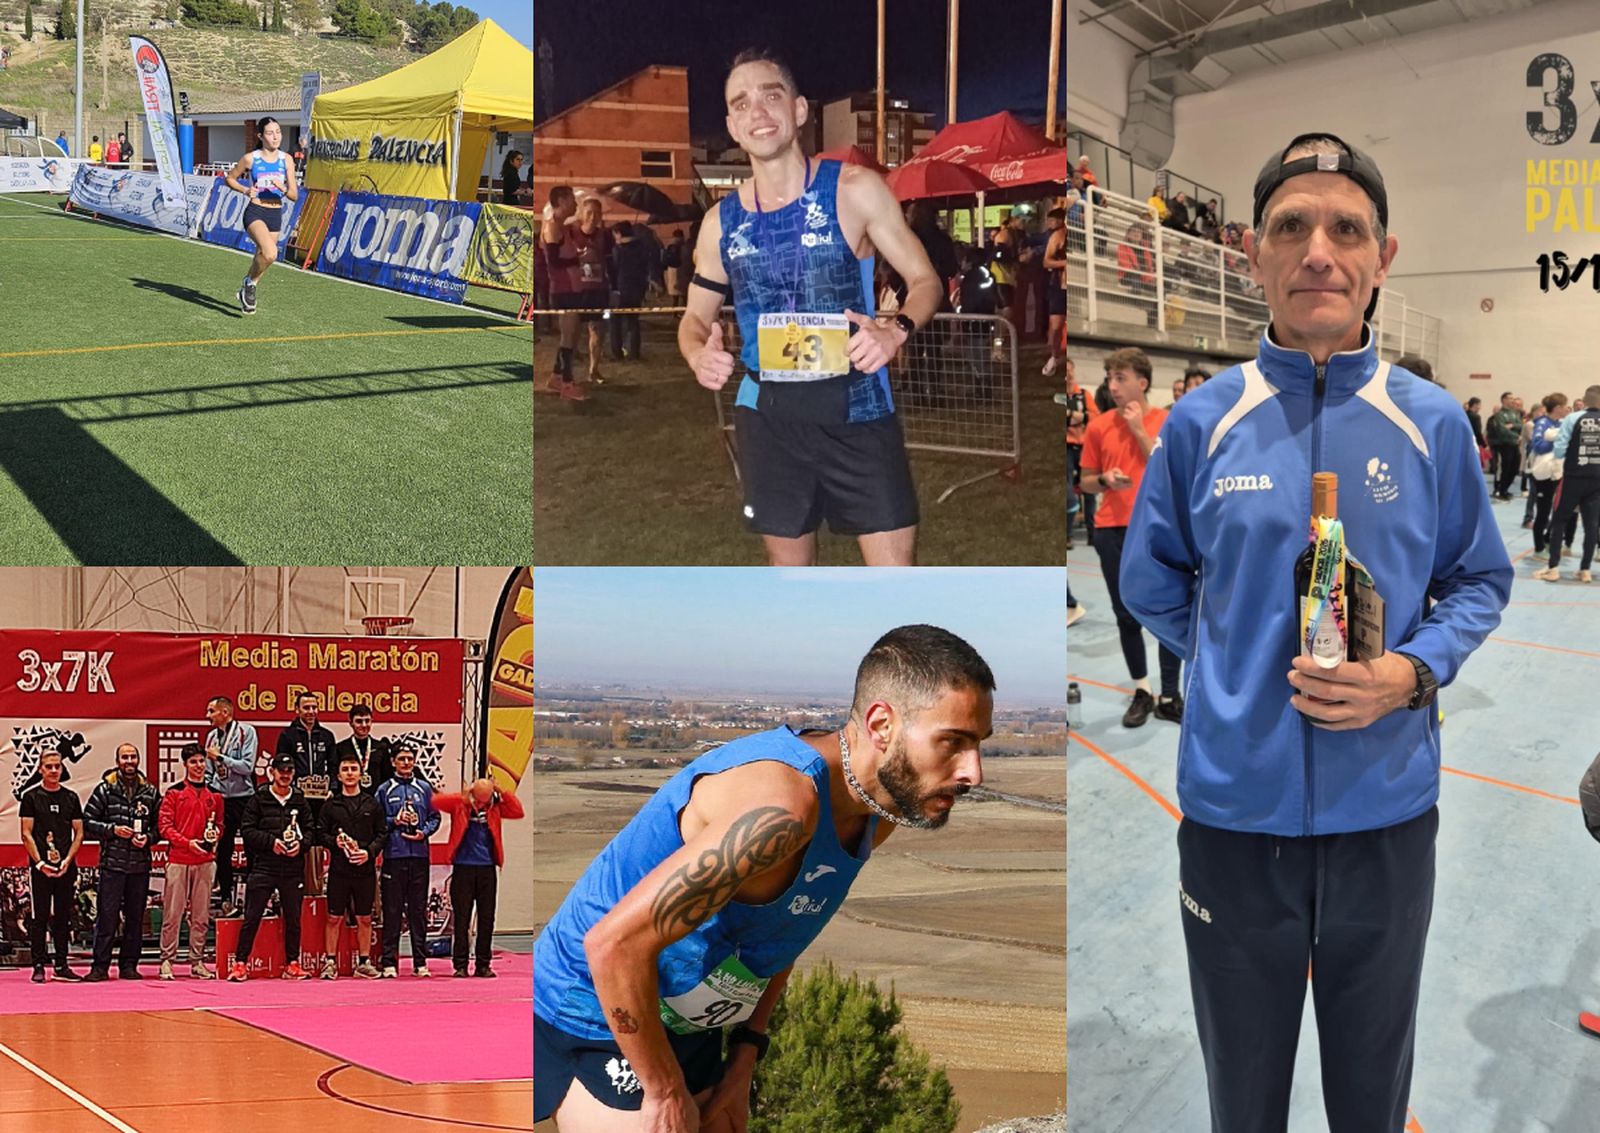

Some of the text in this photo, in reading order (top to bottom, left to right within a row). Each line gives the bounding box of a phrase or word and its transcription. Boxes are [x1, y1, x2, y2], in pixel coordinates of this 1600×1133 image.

[782, 334, 823, 363] 43
[199, 640, 440, 672] Media Maratón
[16, 648, 116, 694] 3x7K
[237, 684, 277, 712] de
[309, 900, 317, 916] 1
[689, 999, 743, 1027] 90
